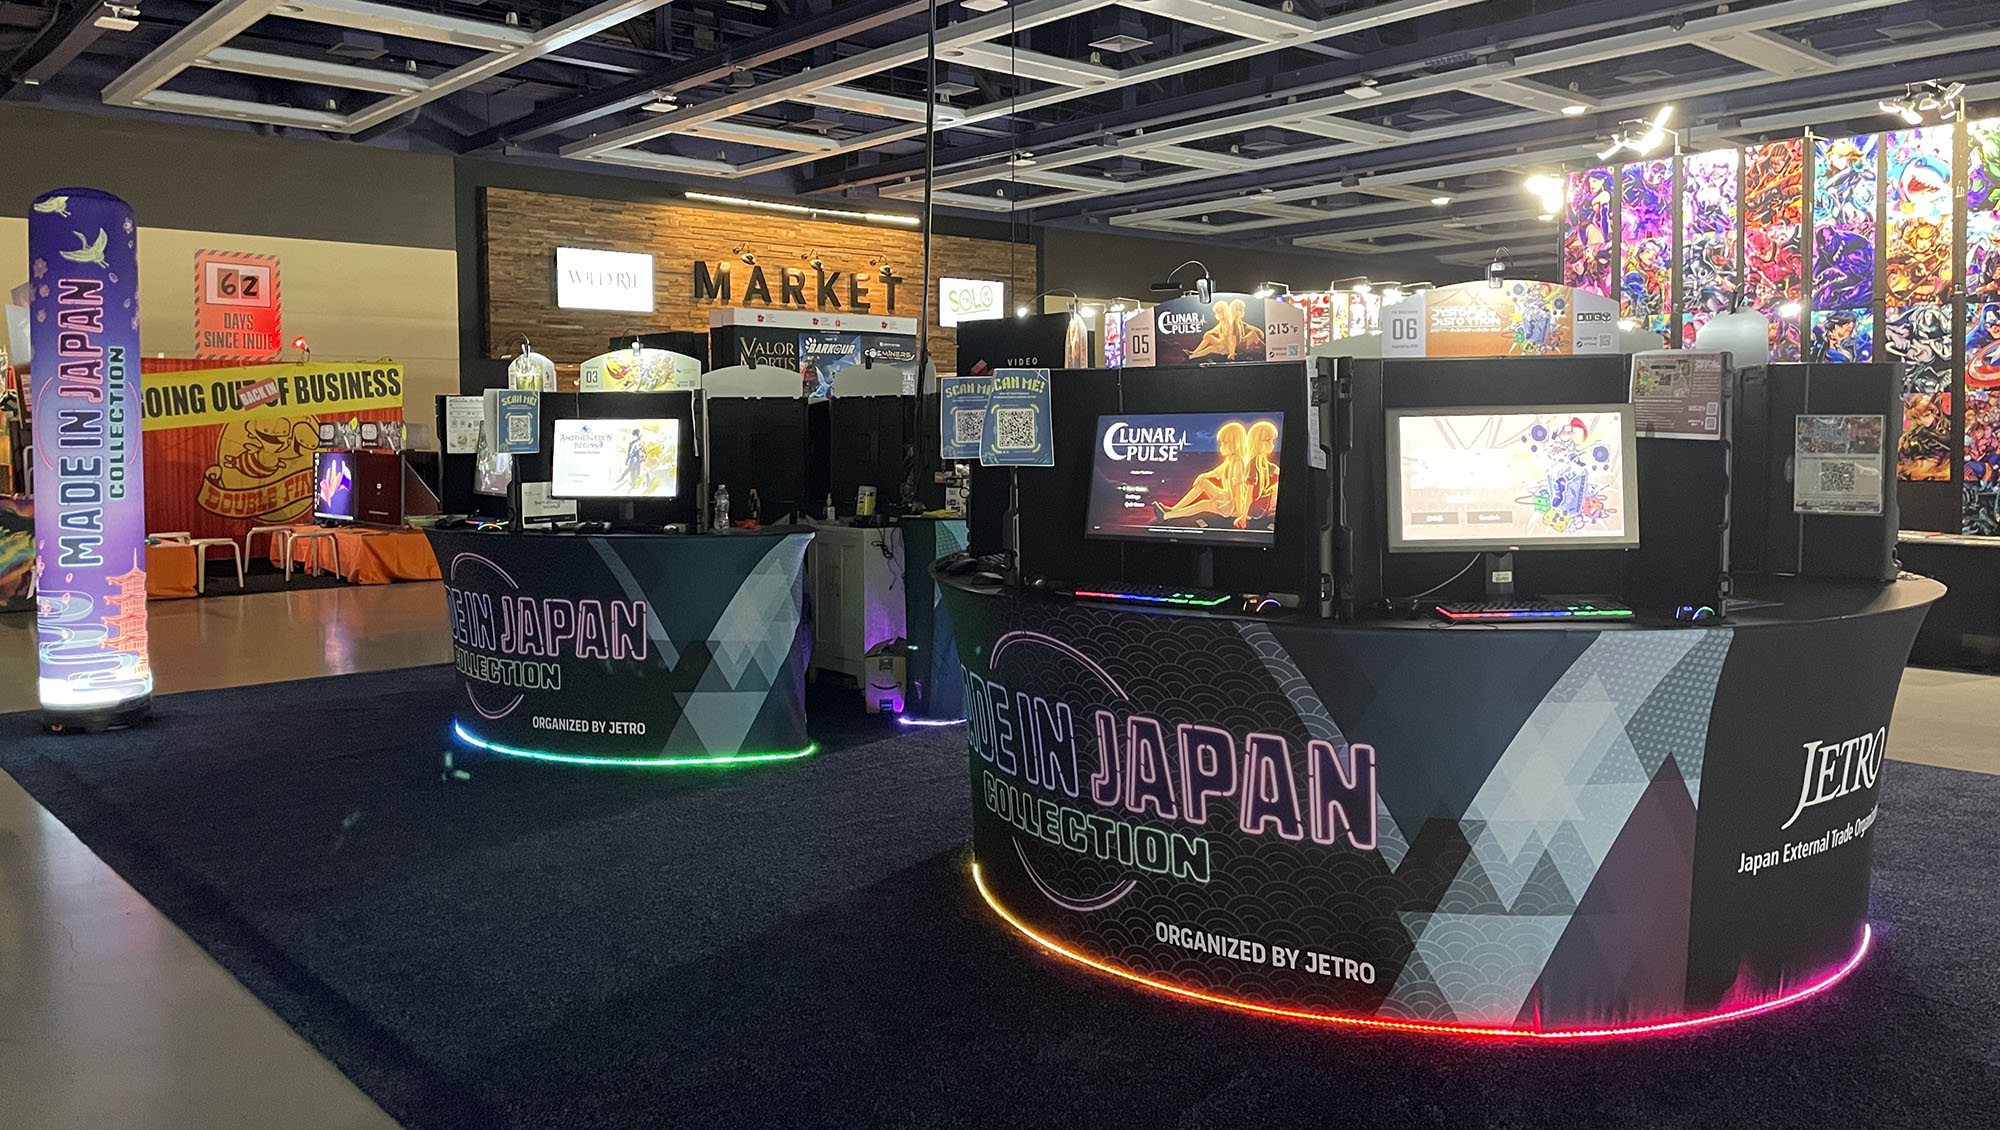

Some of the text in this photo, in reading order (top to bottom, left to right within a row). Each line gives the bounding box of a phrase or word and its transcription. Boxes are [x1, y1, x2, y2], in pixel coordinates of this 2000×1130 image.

[221, 272, 258, 296] 62
[694, 260, 903, 313] MARKET
[948, 285, 993, 312] SOLO
[224, 312, 254, 330] DAYS
[1166, 312, 1199, 324] LUNAR
[1172, 324, 1202, 334] PULSE
[1392, 318, 1417, 340] 06
[204, 331, 273, 350] SINCE INDIE
[740, 336, 795, 357] VALOR
[807, 343, 856, 355] BARKOUR
[1132, 334, 1149, 354] 05
[1007, 357, 1038, 367] VIDEO
[586, 370, 598, 383] 03
[992, 376, 1046, 394] CAN ME!
[142, 384, 206, 418] OING
[211, 379, 256, 412] OU
[294, 368, 401, 404] BUSINESS
[240, 381, 278, 407] BACK IN
[501, 394, 522, 406] SCAN
[945, 383, 975, 398] SCAN
[58, 279, 103, 568] MADE IN JAPAN
[108, 347, 125, 499] COLLECTION
[1119, 427, 1176, 443] LUNAR
[1126, 445, 1179, 462] PULSE
[205, 471, 313, 514] DOUBLE FIN
[464, 591, 496, 651] IN
[501, 595, 648, 660] JAPAN
[532, 715, 646, 735] ORGANIZED BY JETRO
[1016, 692, 1079, 798] IN
[1091, 709, 1377, 851] JAPAN
[1781, 726, 1886, 830] JETRO
[983, 771, 1210, 883] COLLECTION
[1737, 850, 1779, 876] Japan
[1783, 831, 1830, 863] External
[1831, 822, 1854, 848] Trade
[1155, 920, 1376, 985] ORGANIZED BY JETRO
